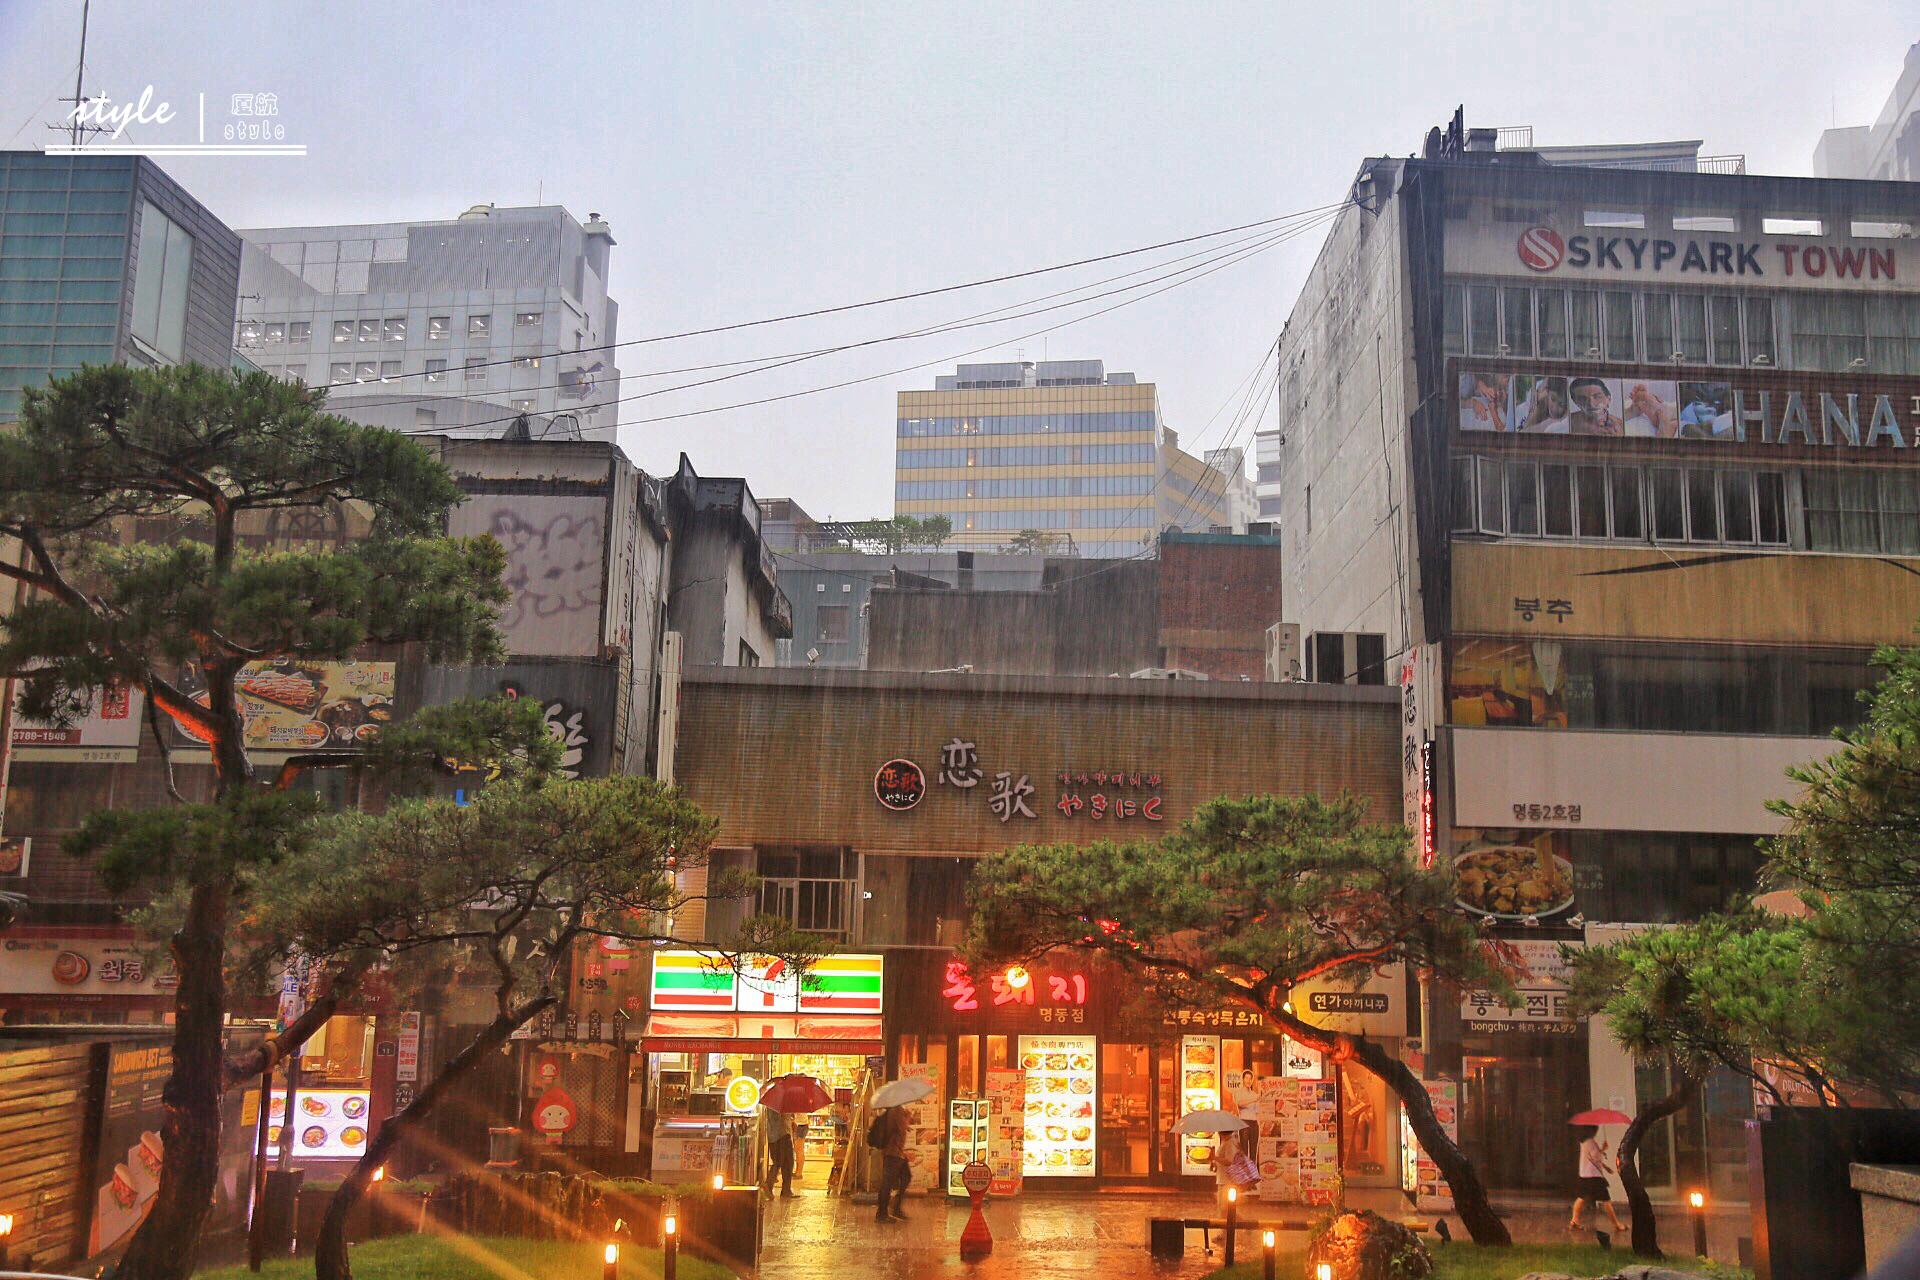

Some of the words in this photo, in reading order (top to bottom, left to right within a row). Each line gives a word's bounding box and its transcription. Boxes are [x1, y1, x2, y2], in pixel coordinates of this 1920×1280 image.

[1567, 234, 1763, 277] SKYPARK
[1776, 243, 1897, 280] TOWN
[1732, 389, 1906, 449] HANA
[1513, 596, 1575, 624] 봉추
[1403, 683, 1418, 782] 恋歌
[938, 737, 1038, 823] 恋歌
[1057, 793, 1163, 820] やきにく
[1512, 803, 1582, 822] 명동2호점
[1039, 1008, 1084, 1023] 명동점
[1314, 995, 1342, 1010] 연가
[1343, 998, 1386, 1010] 야끼니꾸
[1471, 1021, 1510, 1034] bongchu
